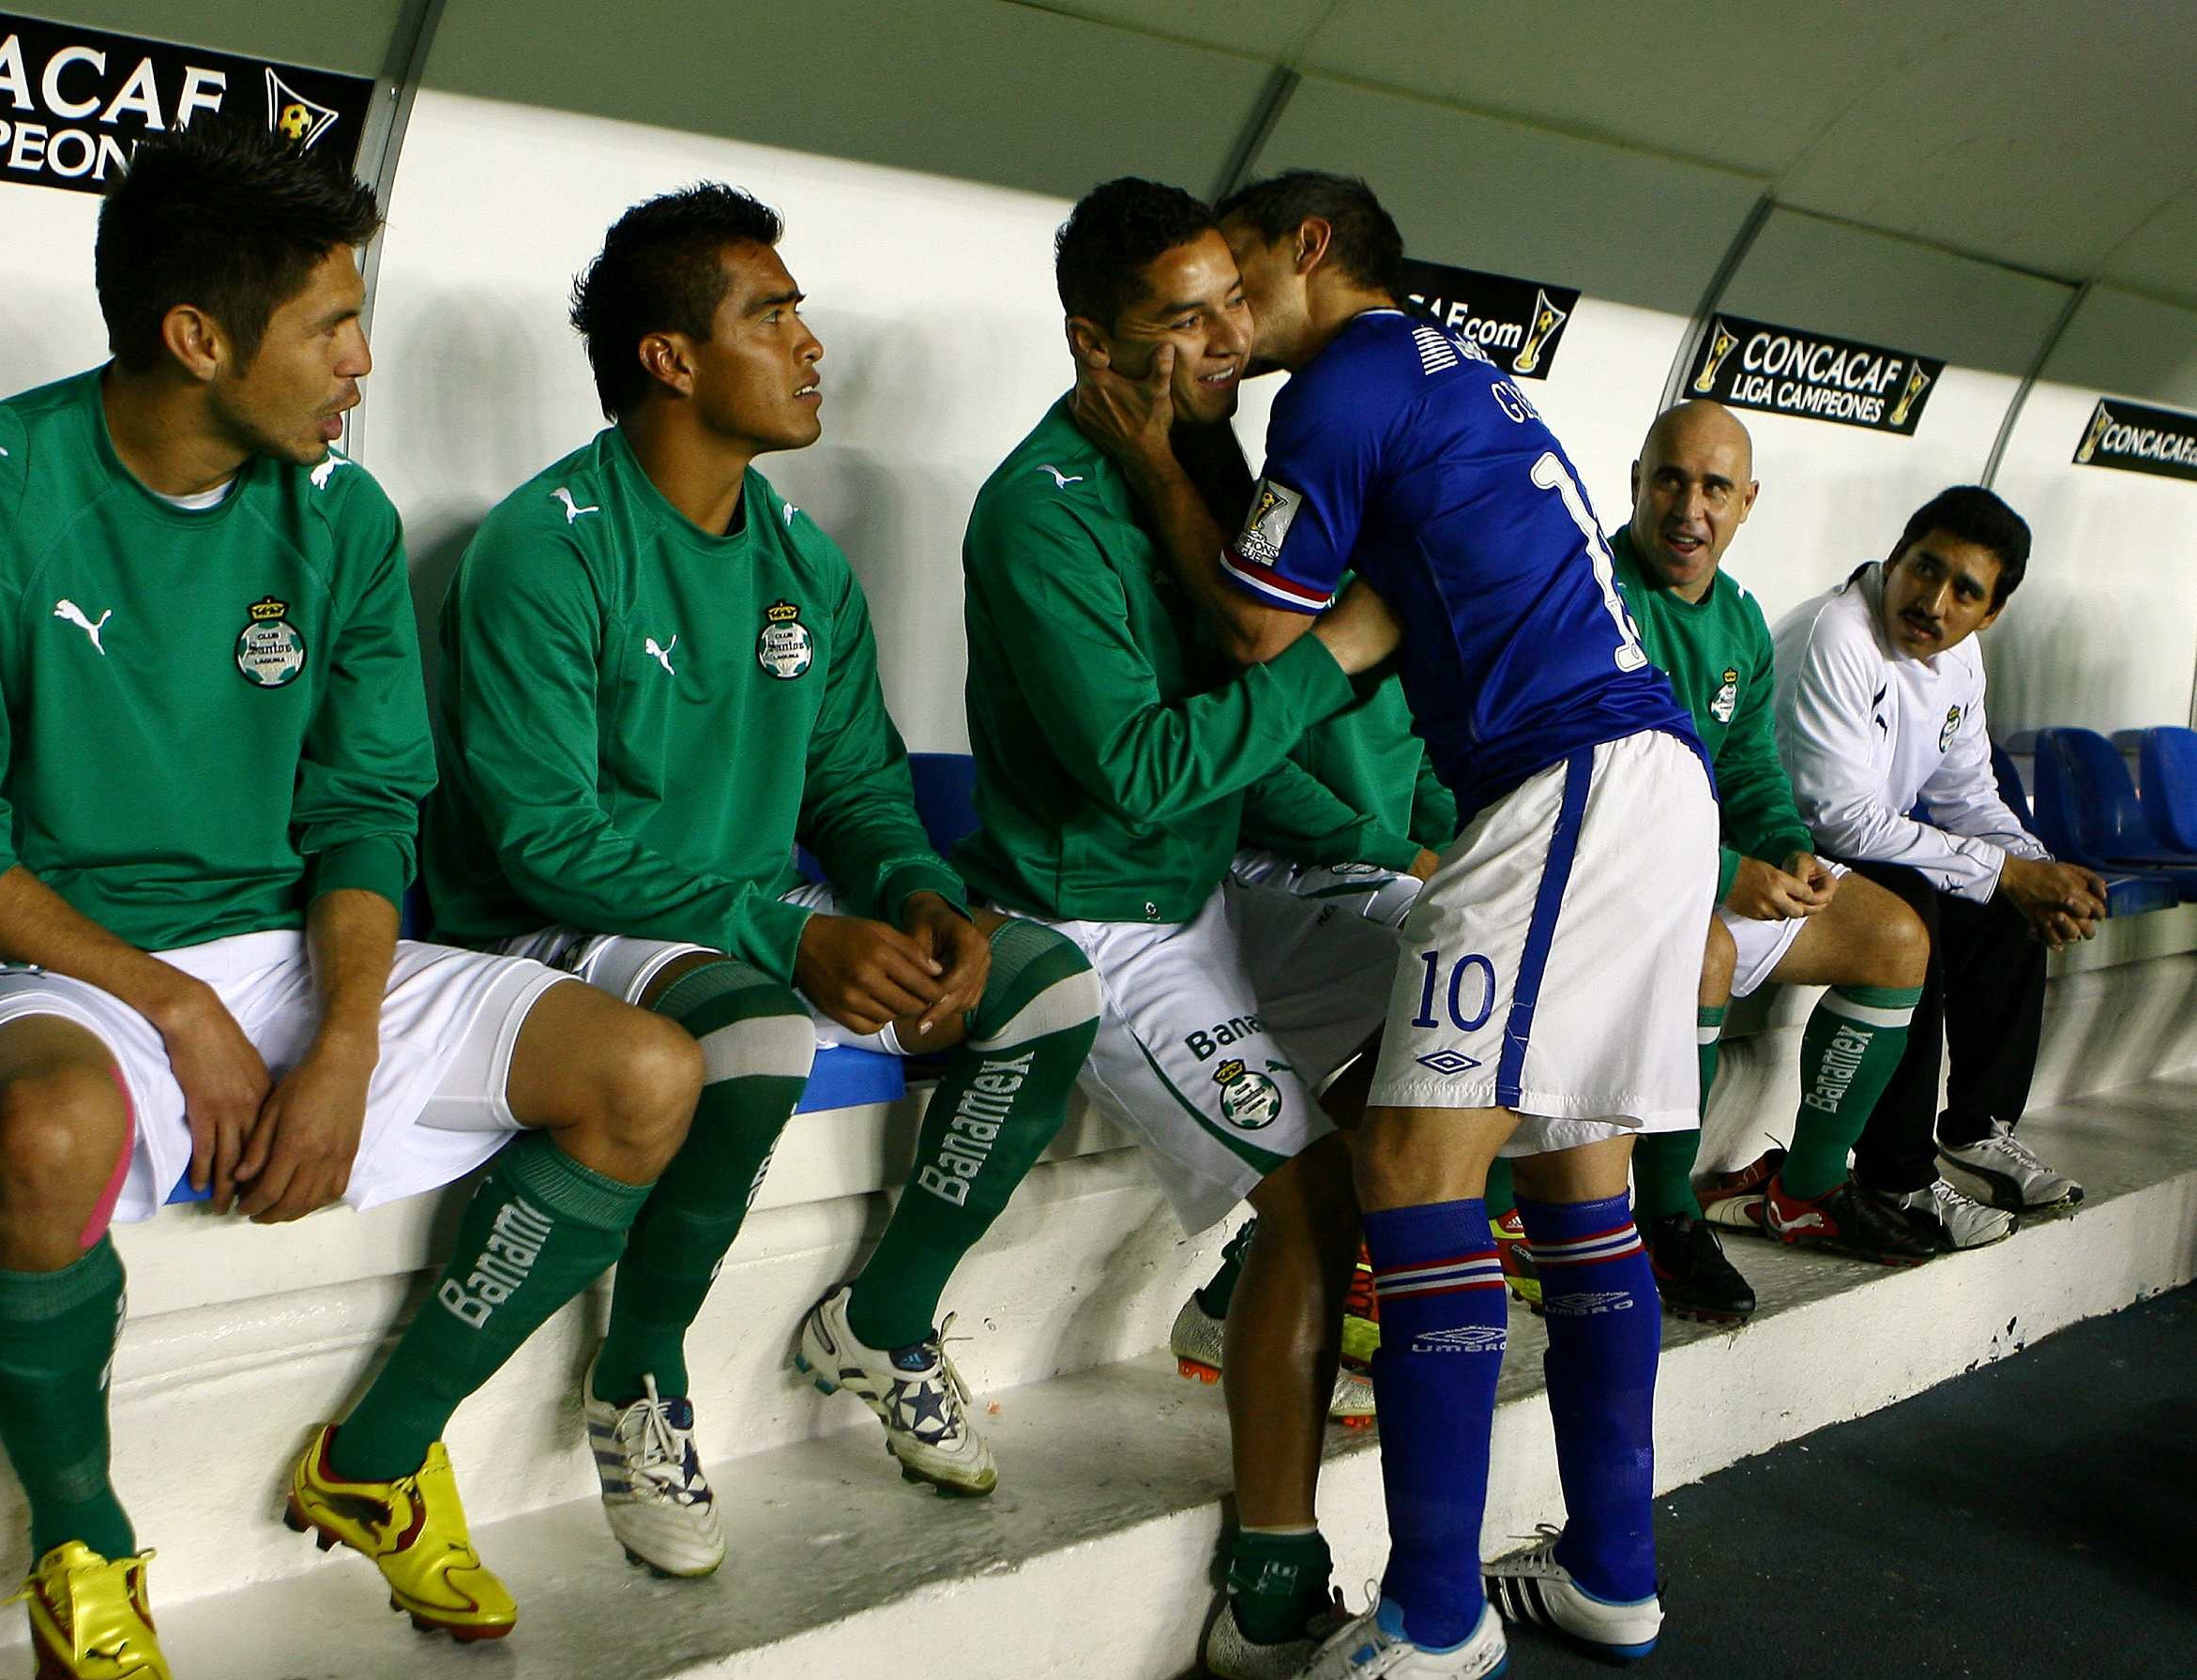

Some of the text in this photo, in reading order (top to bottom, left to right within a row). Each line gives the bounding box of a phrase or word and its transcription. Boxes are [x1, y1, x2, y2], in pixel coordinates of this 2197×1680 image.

[1730, 373, 1885, 422] LIGA CAMPEONES
[1743, 332, 1902, 394] CONCACAF
[1412, 950, 1496, 1033] 10
[1805, 1023, 1874, 1114] Banamex
[917, 1051, 1035, 1207] Banamex
